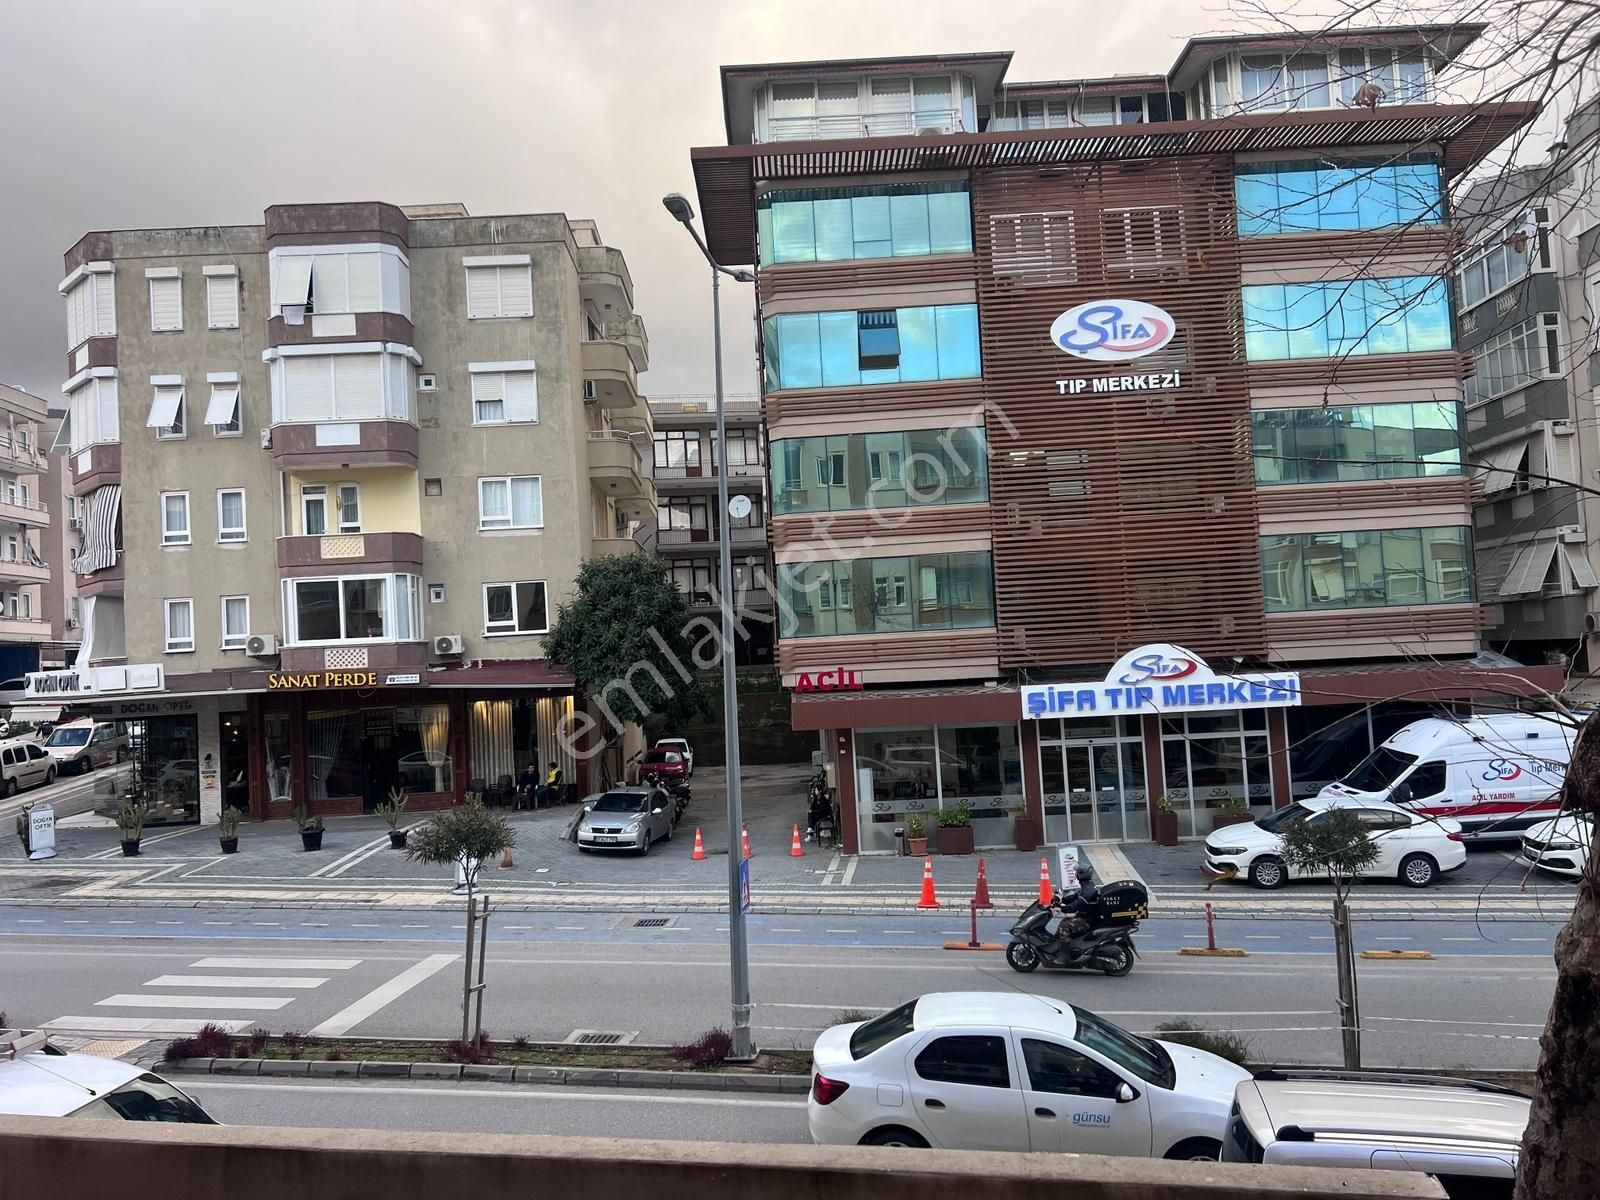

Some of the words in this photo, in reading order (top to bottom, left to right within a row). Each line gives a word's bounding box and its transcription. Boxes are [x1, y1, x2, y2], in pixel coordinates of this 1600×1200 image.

[1056, 379, 1087, 395] TIP
[1092, 370, 1181, 393] MERKEZİ
[269, 673, 320, 689] SANAT
[324, 672, 377, 687] PERDE
[1027, 686, 1097, 718] ŞİFA
[1104, 686, 1154, 709] TIP
[1072, 1111, 1111, 1124] günsu
